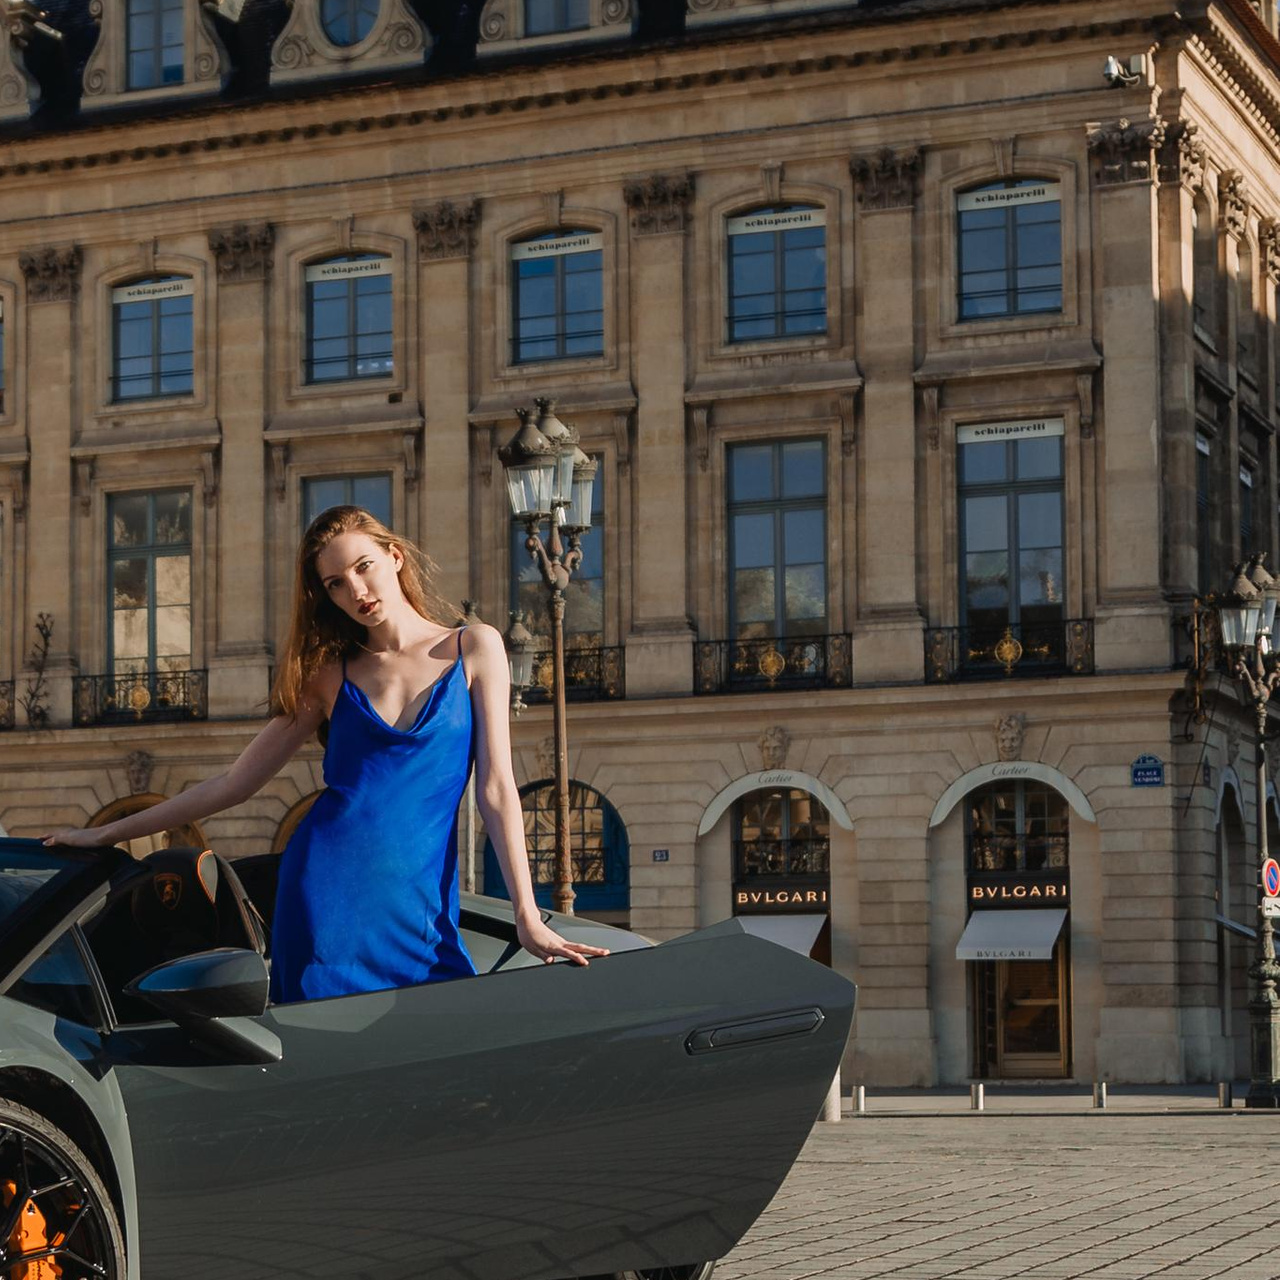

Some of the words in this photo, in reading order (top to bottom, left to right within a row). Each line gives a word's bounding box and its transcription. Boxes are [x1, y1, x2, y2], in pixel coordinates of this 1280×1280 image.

[975, 188, 1045, 203] schiaparelli
[745, 213, 812, 227] schiaparelli
[527, 238, 590, 252] schiaparelli
[321, 263, 381, 275] schiaparelli
[127, 284, 183, 296] schiaparelli
[974, 423, 1046, 436] schiaparelli
[991, 764, 1031, 776] Cartier
[758, 772, 793, 784] Cartier
[737, 891, 827, 903] BVLGARI
[971, 885, 1067, 898] BVLGARI
